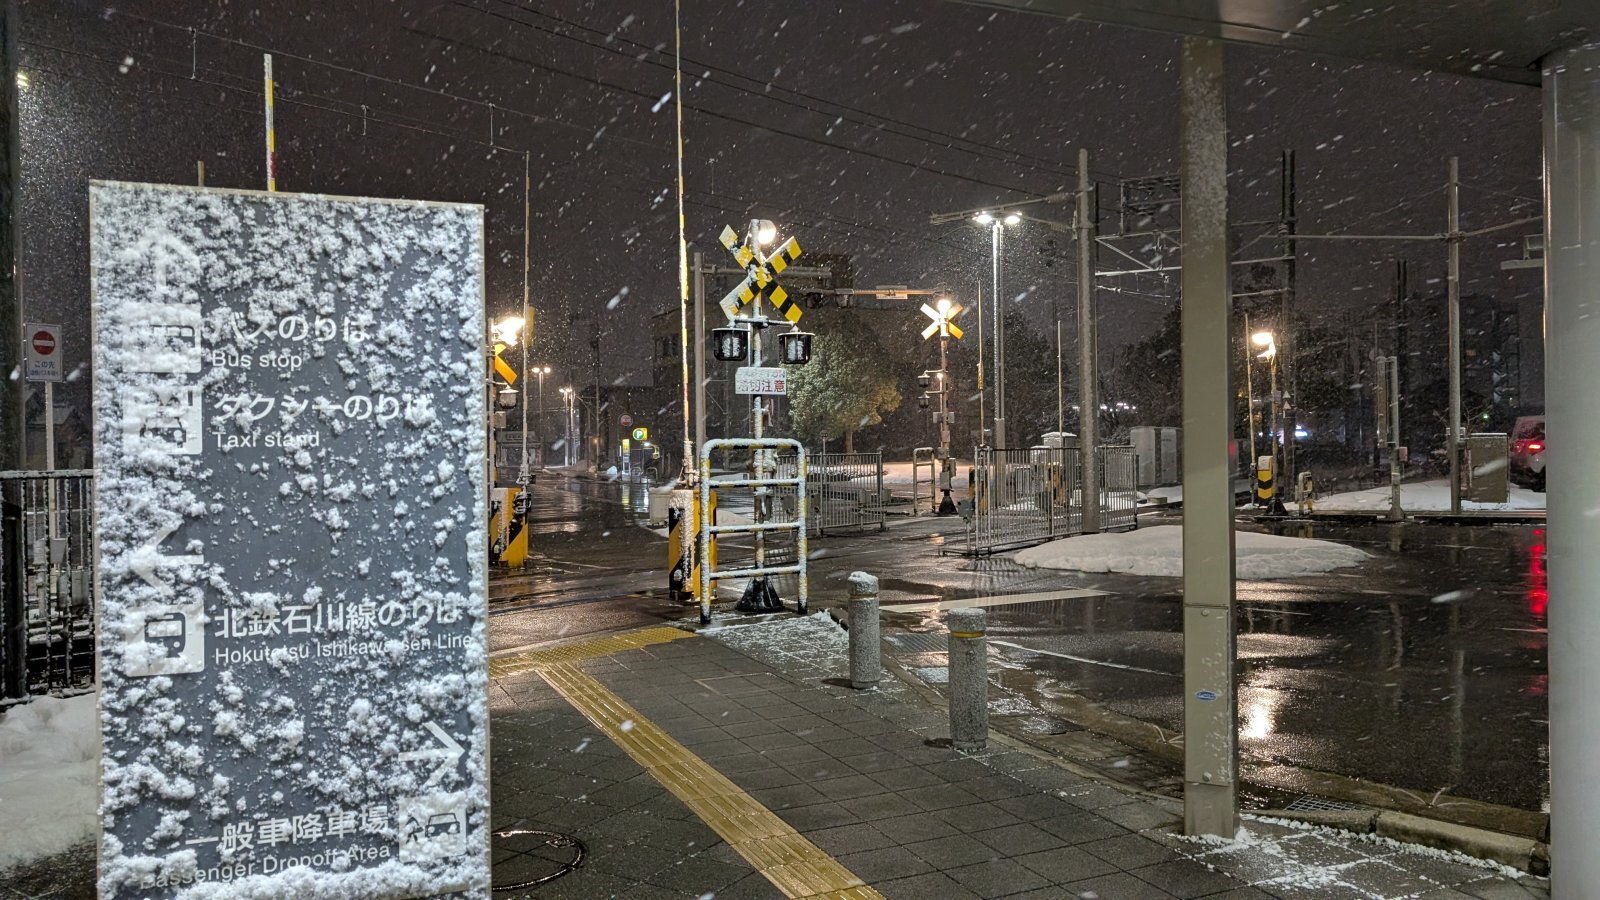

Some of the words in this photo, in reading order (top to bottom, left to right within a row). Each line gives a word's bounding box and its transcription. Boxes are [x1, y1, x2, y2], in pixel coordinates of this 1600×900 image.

[212, 351, 251, 367] Bus
[259, 352, 302, 371] stop
[212, 431, 256, 447] Taxi
[264, 430, 320, 447] stand
[437, 633, 472, 649] Line
[185, 805, 389, 852] 一般車降車場
[345, 845, 391, 862] Area
